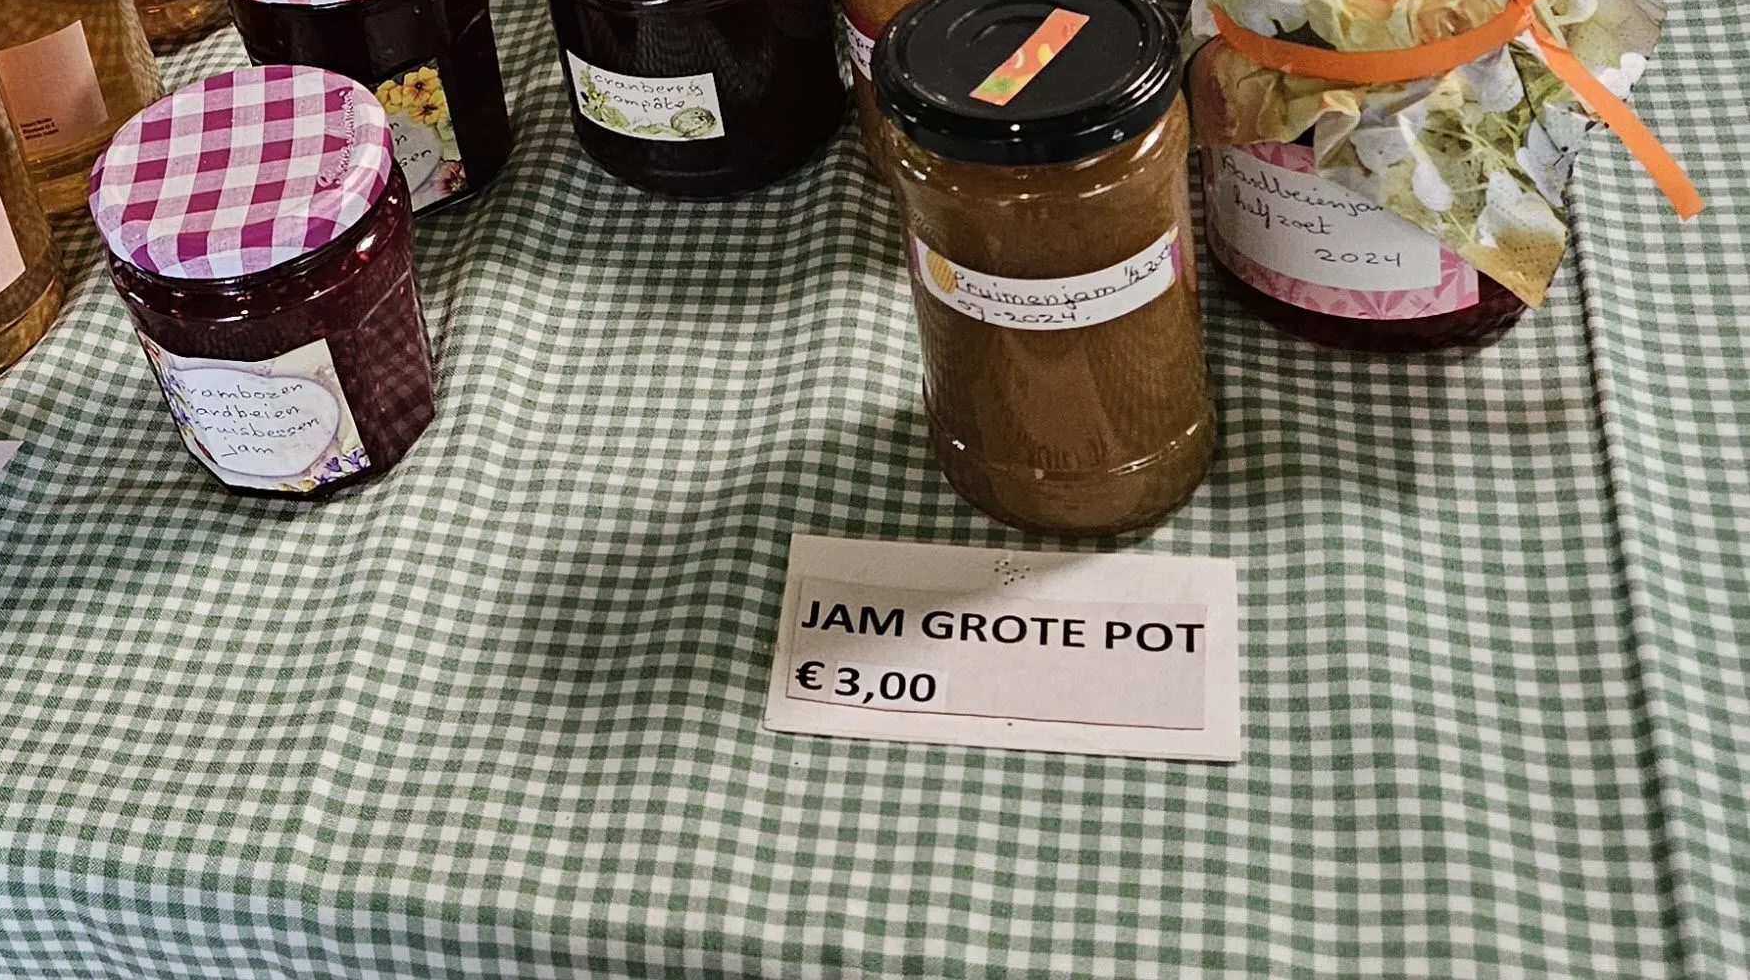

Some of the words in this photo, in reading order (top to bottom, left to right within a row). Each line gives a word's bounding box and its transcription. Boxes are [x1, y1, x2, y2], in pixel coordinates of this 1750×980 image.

[593, 72, 704, 96] cranberry
[1314, 248, 1402, 268] 2024
[953, 270, 1117, 310] Pruimenjam
[801, 600, 905, 638] JAM
[921, 610, 1086, 648] GROTE
[1105, 621, 1205, 654] POT
[795, 660, 826, 691] €
[834, 667, 937, 705] 3,00
